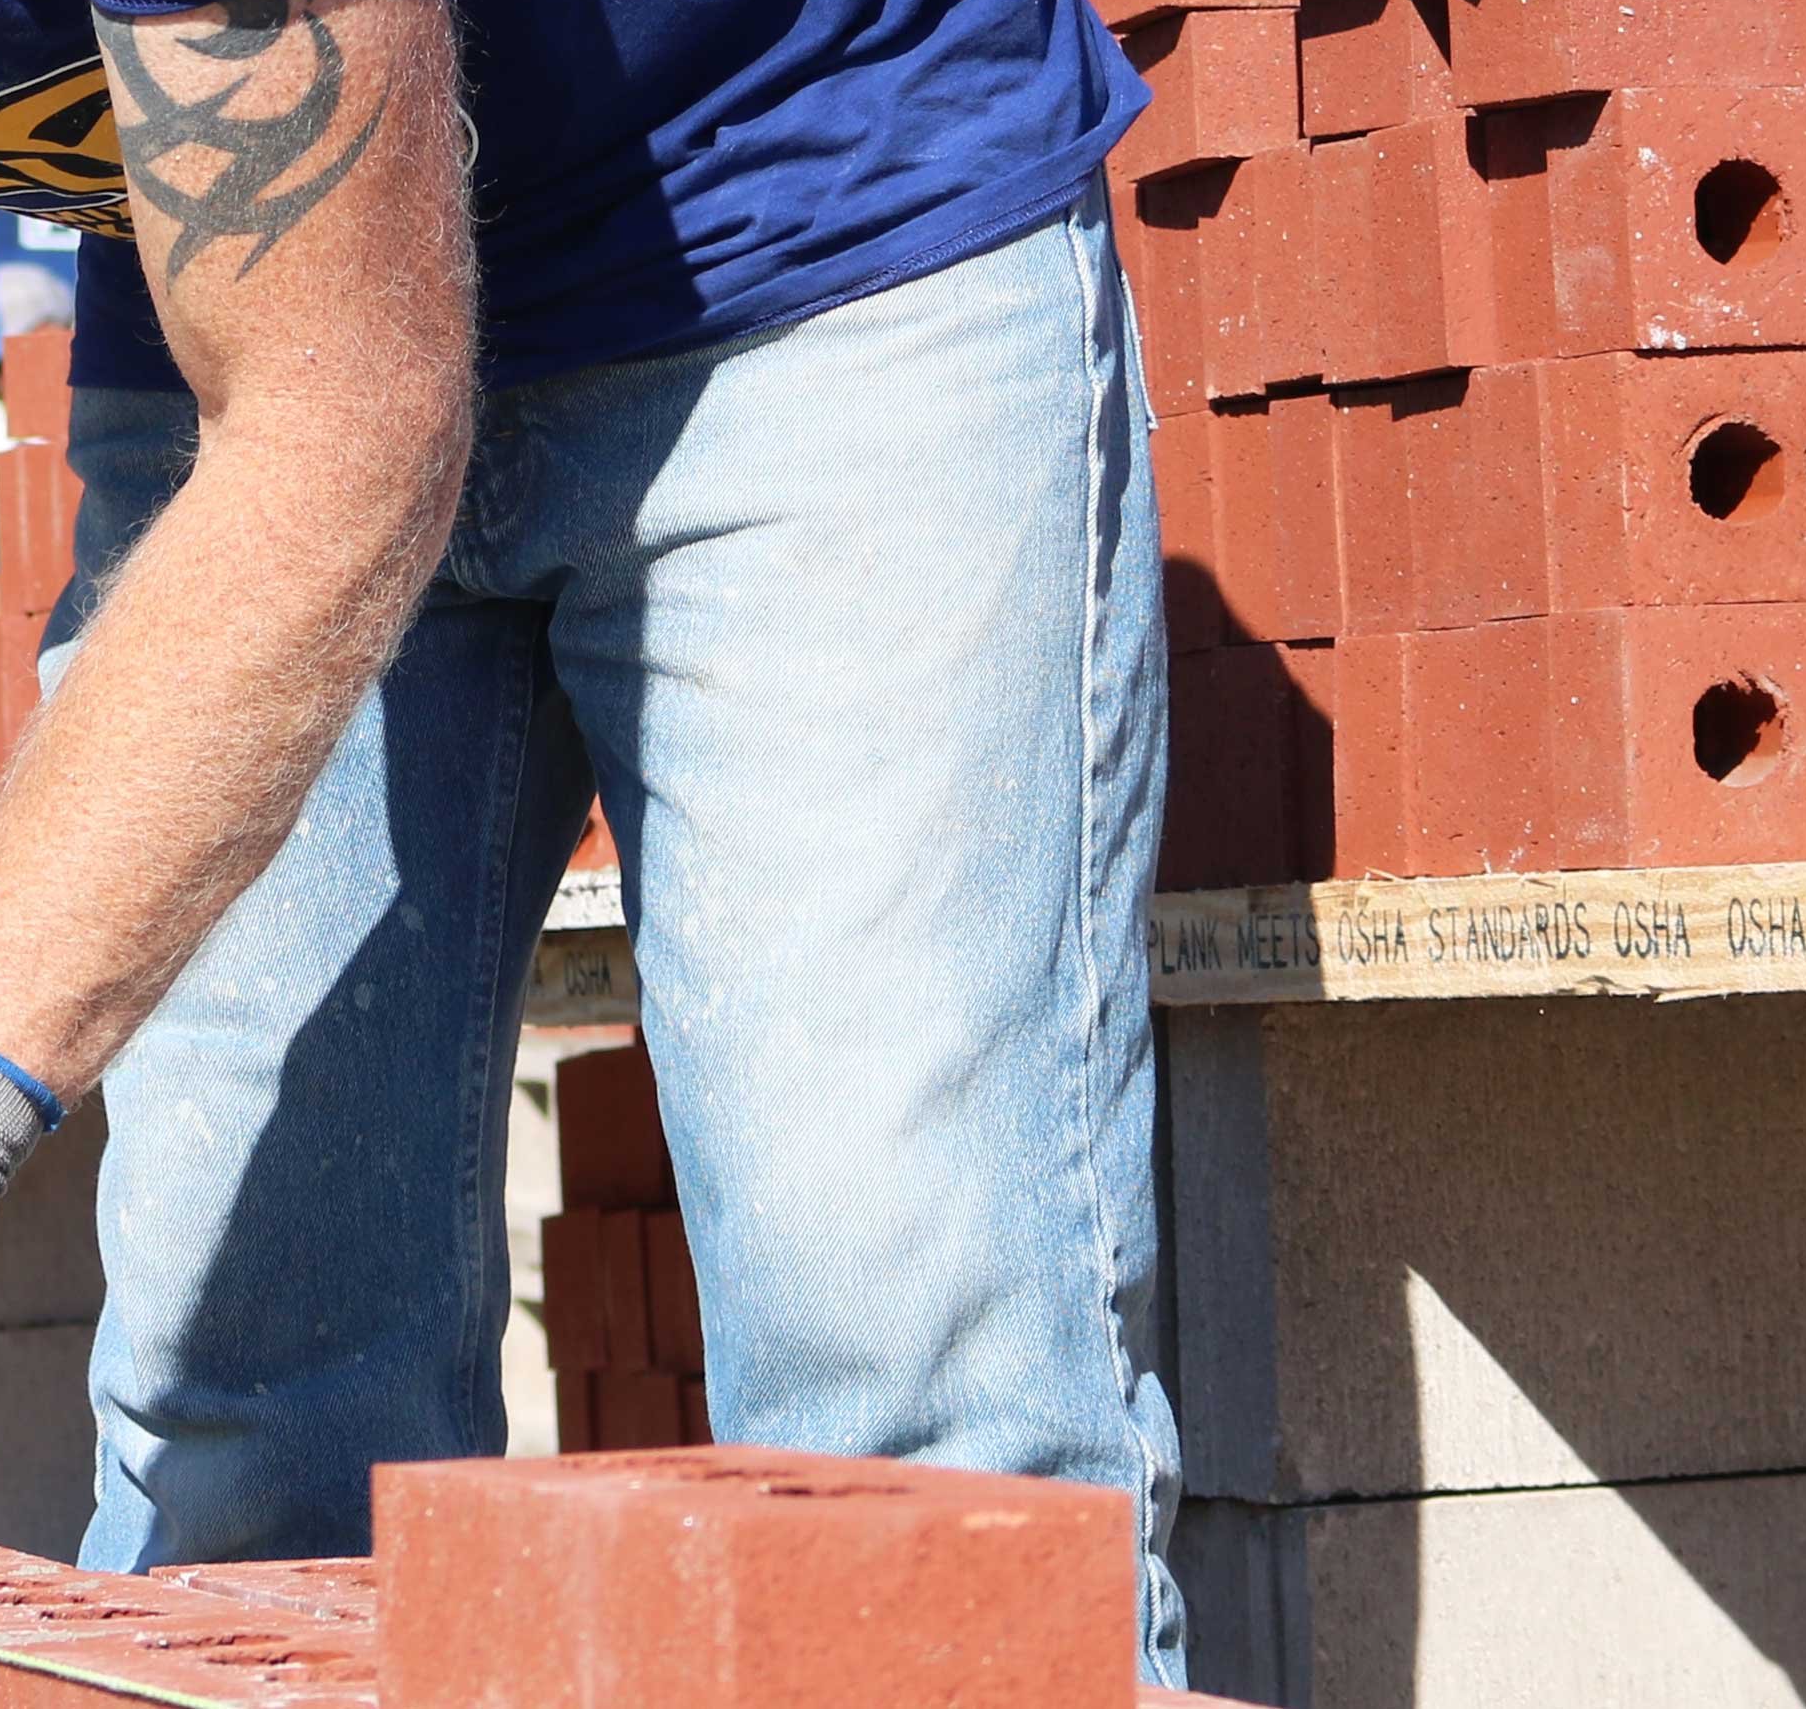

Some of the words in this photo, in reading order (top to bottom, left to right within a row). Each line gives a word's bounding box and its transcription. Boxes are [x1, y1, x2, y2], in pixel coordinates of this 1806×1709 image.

[1237, 910, 1321, 971] MEETS
[1336, 900, 1406, 965] OSHA
[1427, 896, 1592, 964] STANDARDS
[1613, 896, 1691, 959] OSHA
[1727, 896, 1806, 957] OSHA
